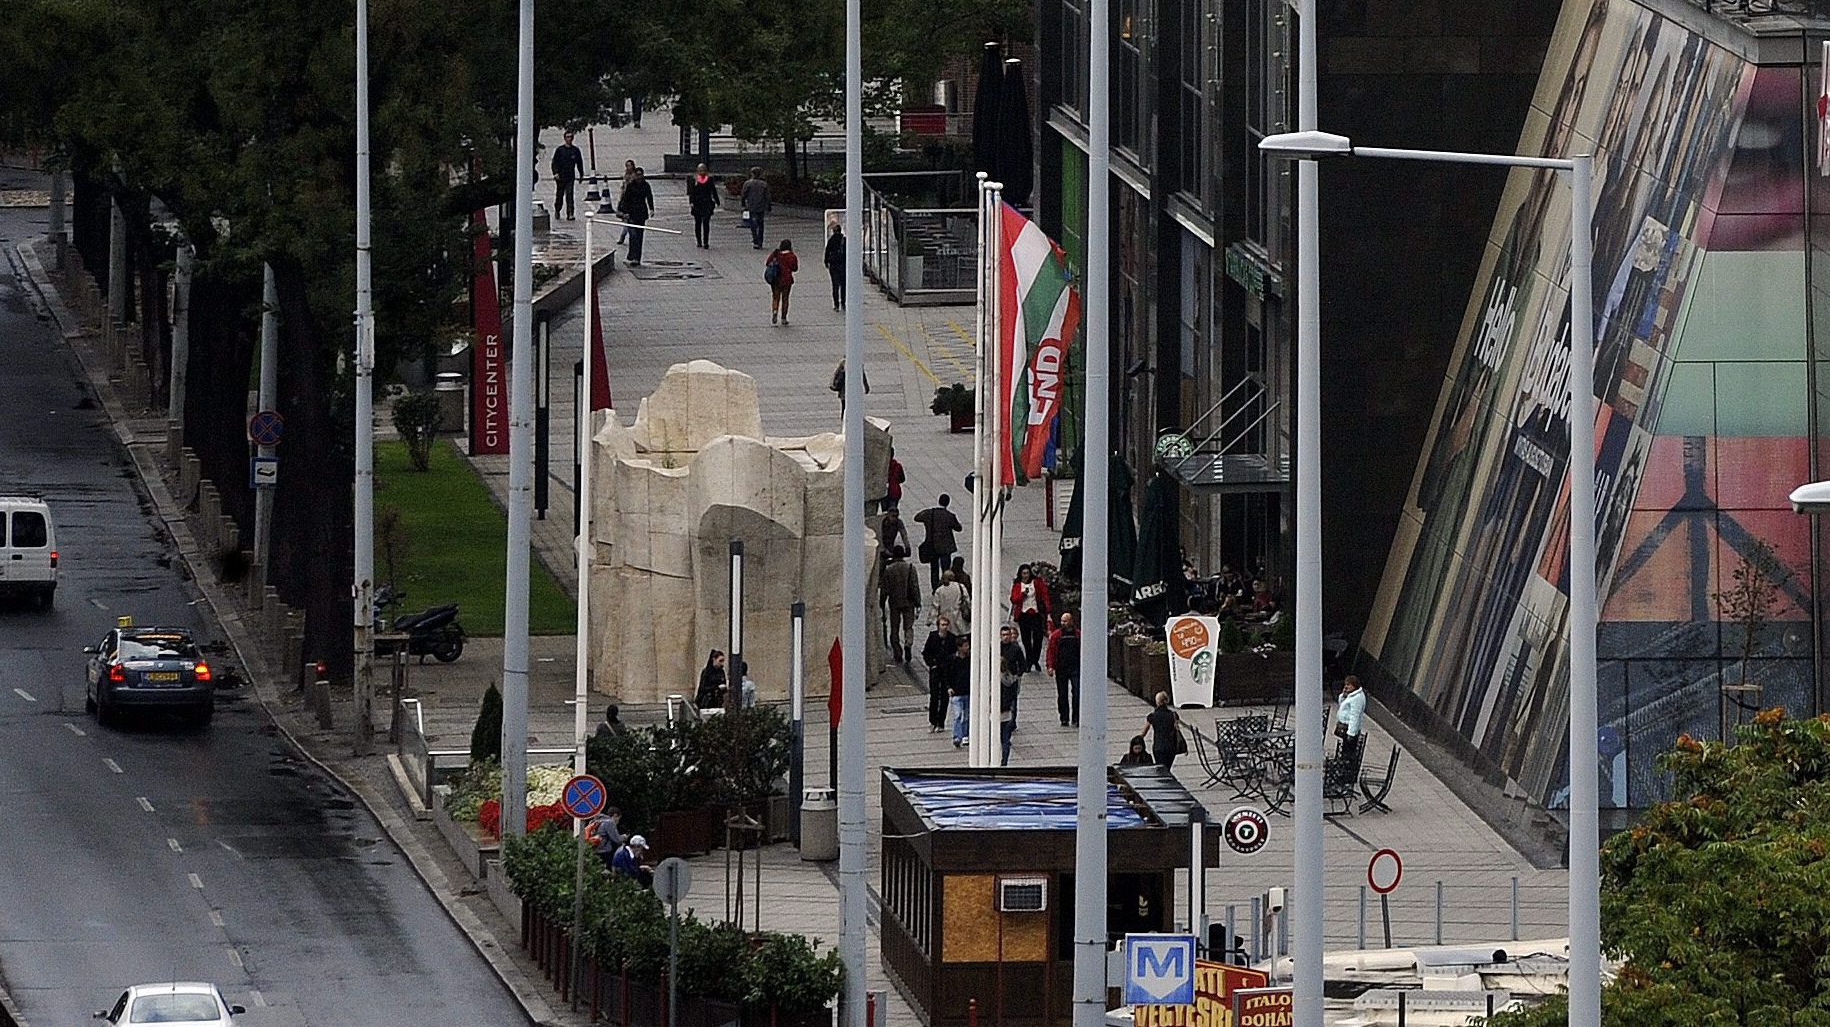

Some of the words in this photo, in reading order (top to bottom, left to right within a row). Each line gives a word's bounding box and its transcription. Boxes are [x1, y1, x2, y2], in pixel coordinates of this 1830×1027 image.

[1474, 276, 1517, 373] Hello
[486, 333, 498, 448] CITYCENTER
[1245, 994, 1294, 1010] ITALO
